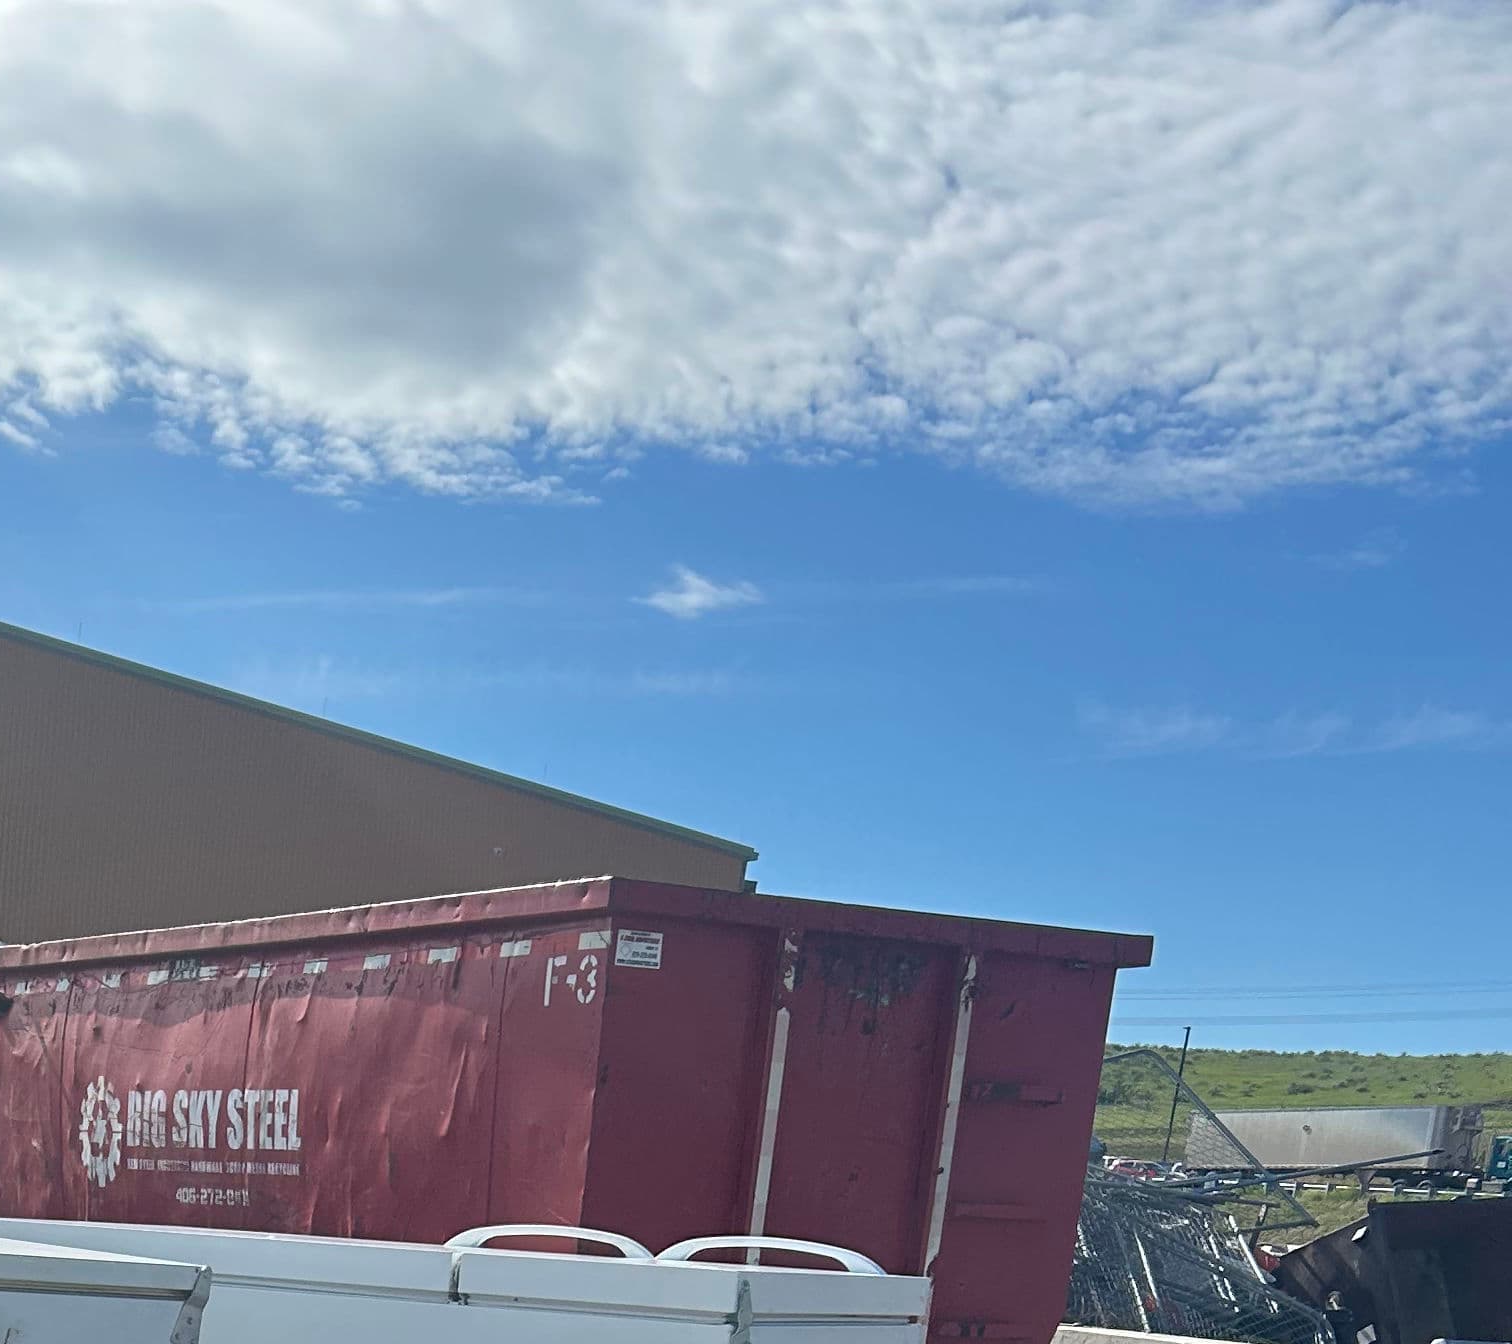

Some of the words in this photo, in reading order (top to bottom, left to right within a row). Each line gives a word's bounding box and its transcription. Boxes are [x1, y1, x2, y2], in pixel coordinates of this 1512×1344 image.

[544, 954, 598, 1007] F-3
[126, 1089, 167, 1148] BIG
[171, 1088, 223, 1149] SKY
[226, 1088, 302, 1151] STEEL
